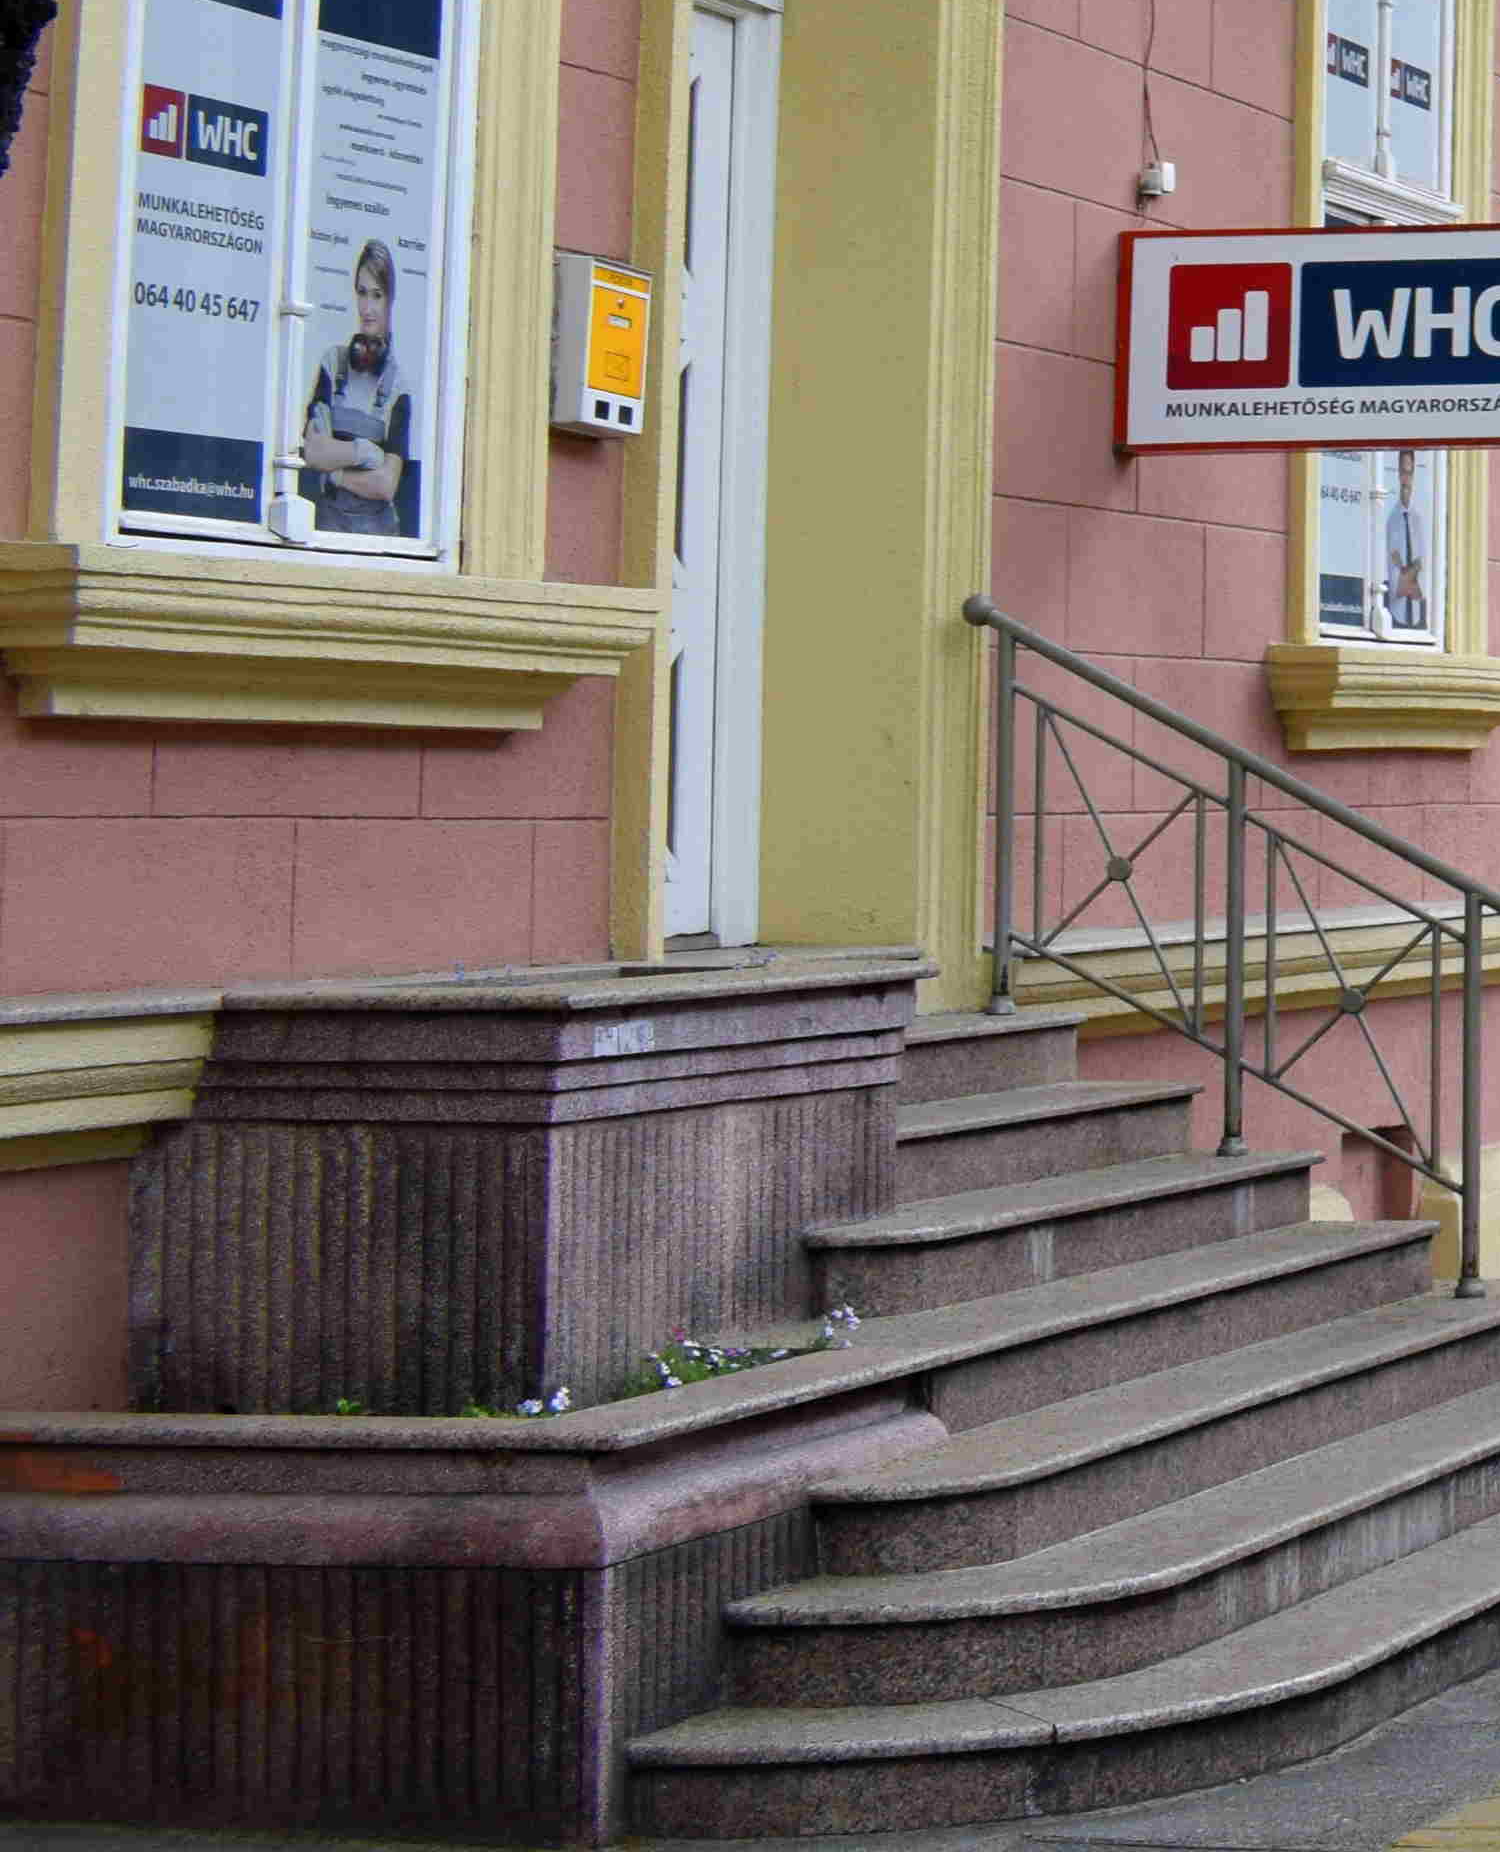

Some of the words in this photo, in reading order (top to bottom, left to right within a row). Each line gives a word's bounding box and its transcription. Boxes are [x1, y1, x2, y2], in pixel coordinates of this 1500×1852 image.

[1344, 47, 1366, 78] WHC
[1406, 71, 1428, 102] WHC
[196, 110, 259, 161] WHC
[138, 192, 264, 230] MUNKALEHETŐSÉG
[136, 218, 263, 253] MAGYARORSZÁGON
[135, 281, 168, 308] 064
[173, 288, 196, 312] 40
[200, 293, 222, 316] 45
[227, 297, 260, 322] 647
[1165, 398, 1355, 418] MUNKALEHETŐSÉG
